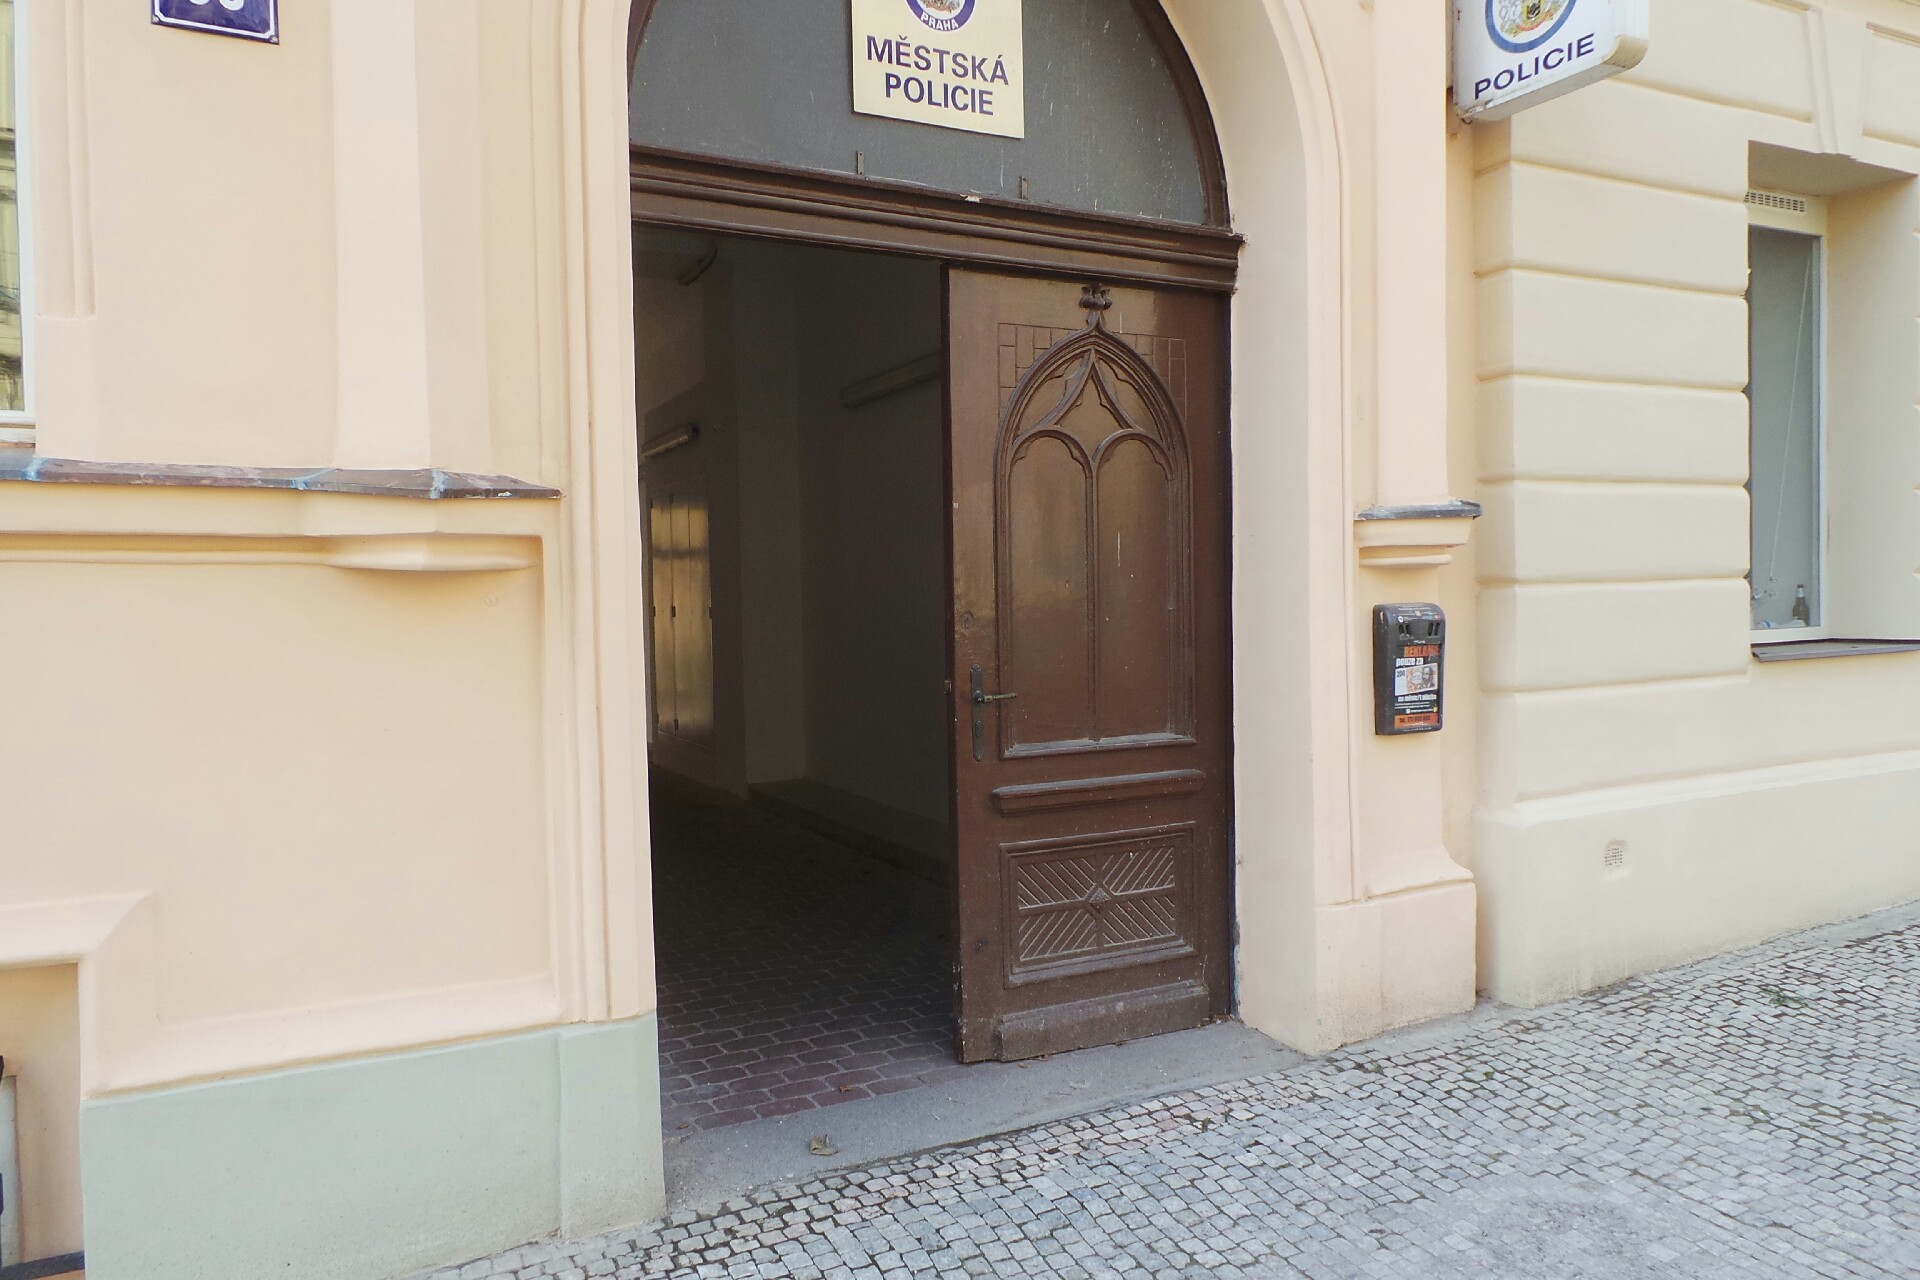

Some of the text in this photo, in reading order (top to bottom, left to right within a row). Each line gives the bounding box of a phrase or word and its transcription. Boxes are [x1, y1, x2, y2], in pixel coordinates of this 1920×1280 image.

[920, 11, 959, 31] PRAHA
[866, 34, 1009, 86] MĚSTSKÁ
[1474, 33, 1595, 100] POLICIE
[885, 72, 994, 116] POLICIE
